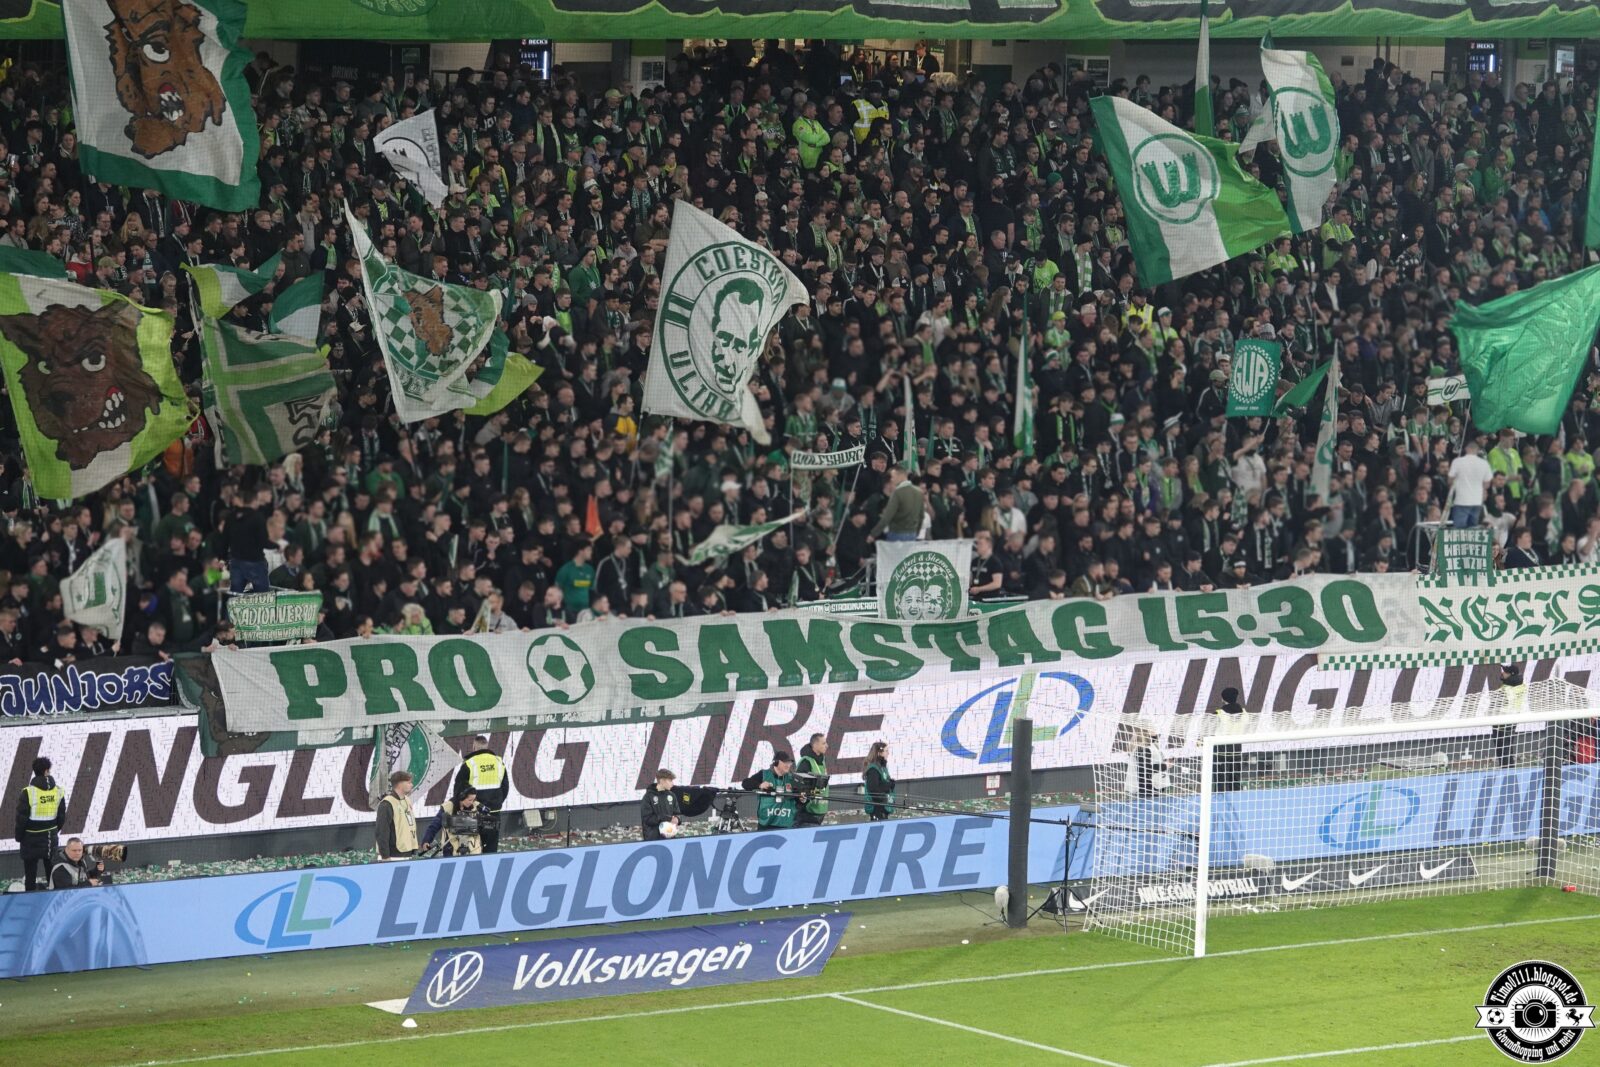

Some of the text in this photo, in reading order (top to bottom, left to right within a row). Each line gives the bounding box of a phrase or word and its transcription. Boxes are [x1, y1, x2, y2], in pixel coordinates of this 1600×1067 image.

[1443, 529, 1489, 543] WAHRES
[1443, 544, 1487, 557] WAPPEN
[269, 580, 1387, 720] PRO SAMSTAG 15:30
[0, 664, 175, 717] JUNIORS
[767, 808, 791, 817] HOST
[376, 834, 787, 939] LINGLONG
[812, 817, 994, 899] TIRE
[512, 943, 752, 990] Volkswagen
